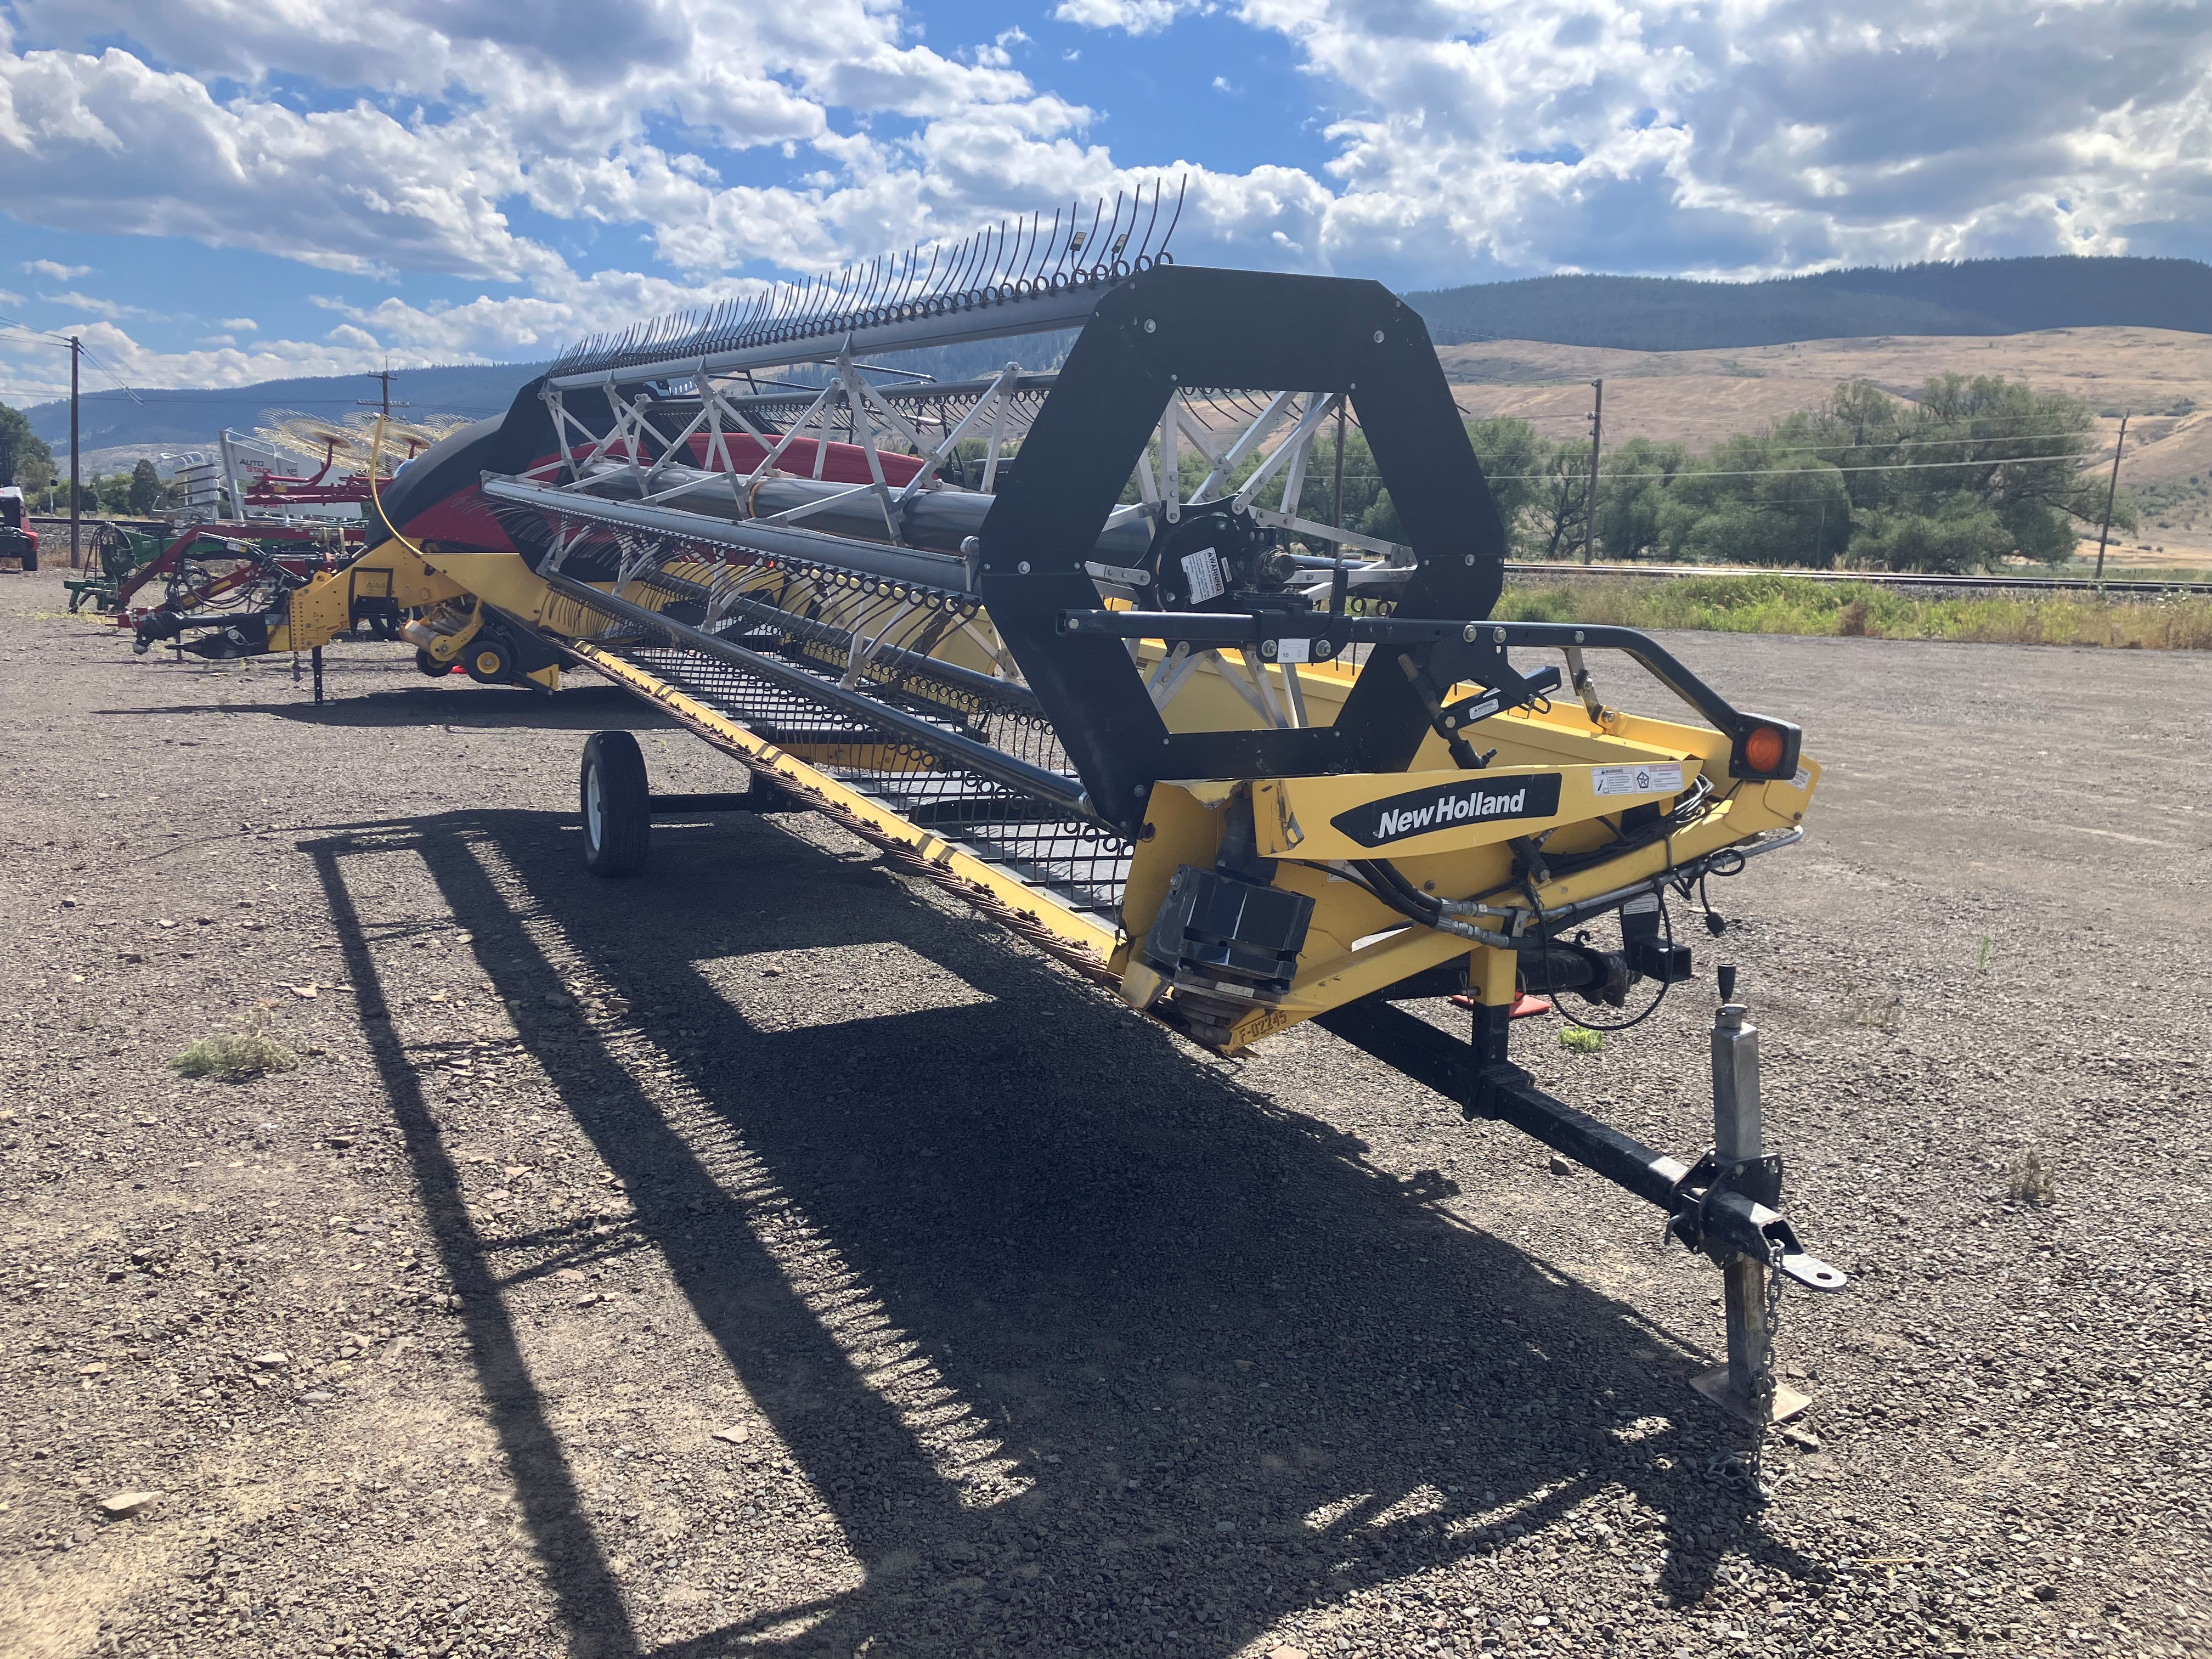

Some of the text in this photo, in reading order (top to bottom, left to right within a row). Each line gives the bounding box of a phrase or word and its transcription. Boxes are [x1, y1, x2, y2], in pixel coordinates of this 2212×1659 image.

[239, 459, 264, 467] AUTO
[246, 465, 273, 474] STACK
[1209, 557, 1222, 591] WARNING
[1379, 788, 1526, 839] New Holland
